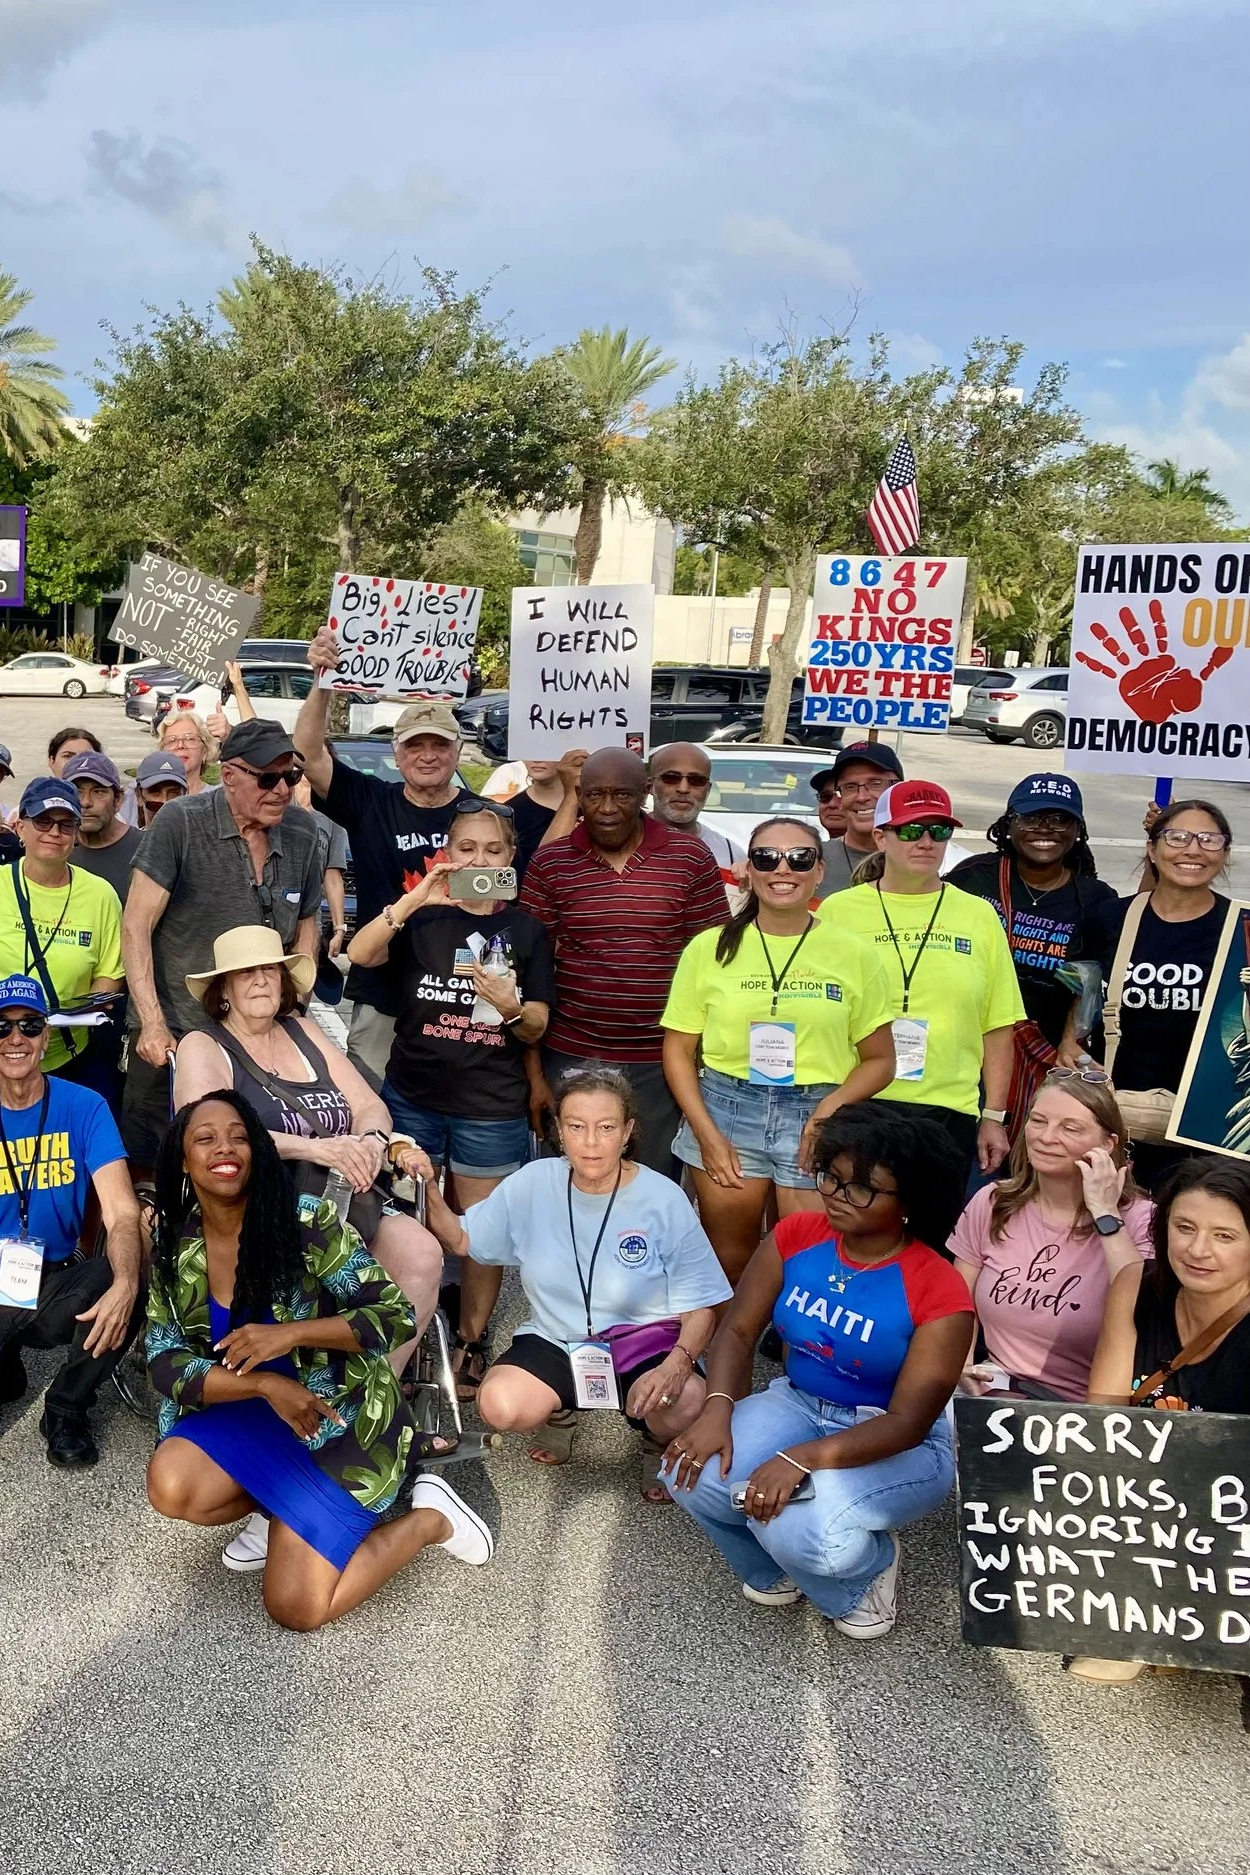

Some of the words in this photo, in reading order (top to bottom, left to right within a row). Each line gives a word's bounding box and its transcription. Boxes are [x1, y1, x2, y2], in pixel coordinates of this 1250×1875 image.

[141, 554, 162, 573] IF
[166, 564, 201, 594] YOU
[205, 584, 237, 609] SEE
[1080, 553, 1203, 594] HANDS
[122, 592, 174, 632] NOT
[143, 577, 241, 637] SOMETHING
[342, 582, 381, 617] Big
[397, 584, 478, 625] Lies!
[527, 596, 546, 620] I
[567, 598, 629, 623] WILL
[851, 588, 917, 614] NO
[411, 617, 475, 649] silence
[536, 626, 638, 654] DEFEND
[818, 615, 953, 644] KINGS
[115, 627, 137, 646] DO
[140, 640, 225, 689] SOMETHING!
[334, 647, 390, 679] GOOD
[395, 647, 468, 685] TROUBLE
[541, 664, 630, 692] HUMAN
[807, 668, 870, 696] WE
[874, 671, 952, 701] THE
[529, 703, 629, 731] RIGHTS
[803, 695, 949, 729] PEOPLE
[1030, 788, 1072, 799] NETWORK
[45, 926, 77, 937] ACTION
[875, 933, 900, 943] HOPE
[904, 933, 910, 941] &
[915, 932, 952, 943] ACTION
[1012, 924, 1049, 940] RIGHTS
[1049, 932, 1070, 944] AND
[1014, 911, 1055, 929] RIGHTS
[1055, 922, 1075, 934] ARE
[1047, 943, 1067, 957] ARE
[416, 987, 457, 1003] SOME
[420, 974, 444, 987] ALL
[740, 981, 767, 990] HOPE
[782, 981, 823, 991] ACTION
[423, 1023, 462, 1041] BONE
[439, 1013, 470, 1028] ONE
[1026, 1244, 1060, 1283] be
[989, 1267, 1082, 1316] kind
[784, 1286, 875, 1344] HAITI
[982, 1408, 1173, 1463] SORRY
[964, 1502, 1215, 1555] IGNORING
[967, 1540, 1116, 1578] WHAT
[968, 1577, 1205, 1642] GERMANS
